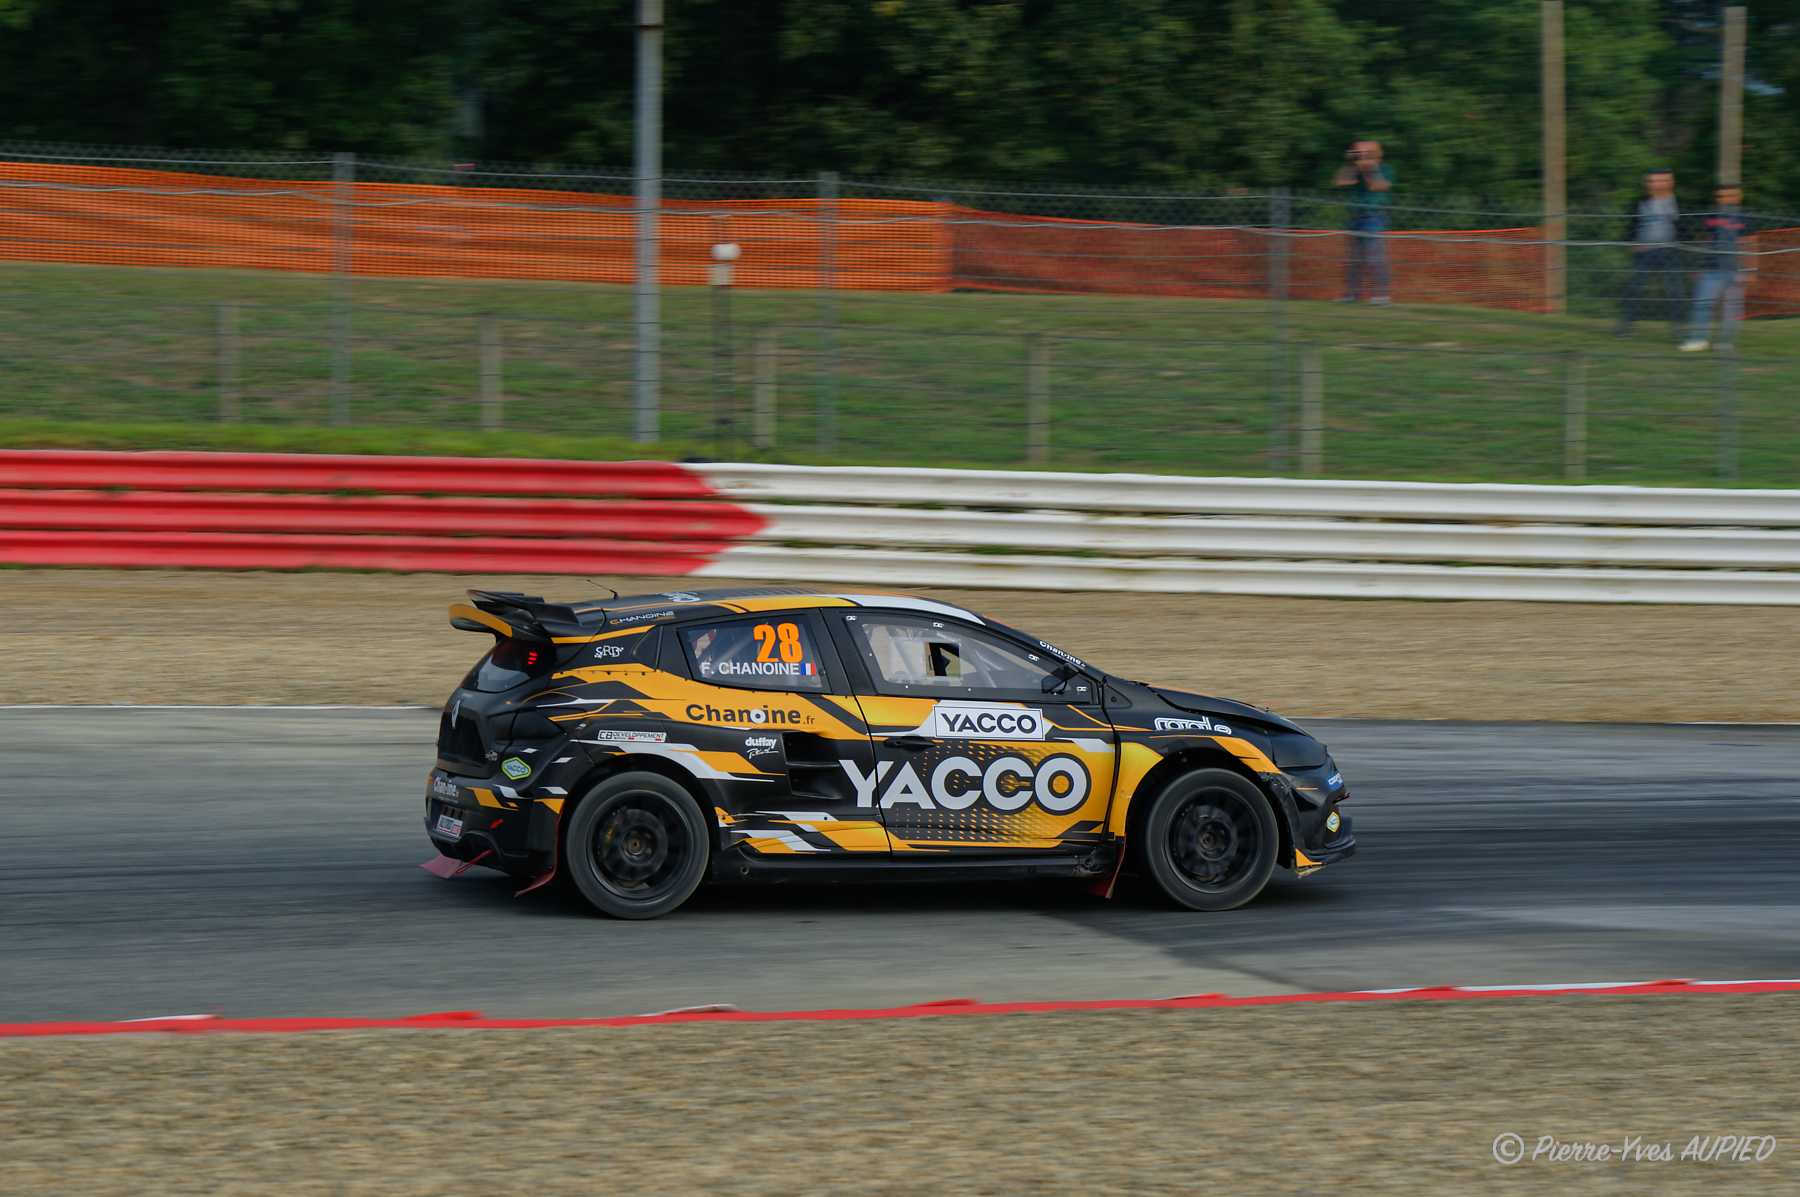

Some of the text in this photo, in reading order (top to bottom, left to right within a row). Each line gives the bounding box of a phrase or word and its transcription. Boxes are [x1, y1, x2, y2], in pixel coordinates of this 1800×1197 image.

[753, 622, 803, 662] 28
[701, 662, 800, 675] F. CHANOINE
[941, 712, 1037, 734] YACCO
[838, 756, 1088, 811] YACCO
